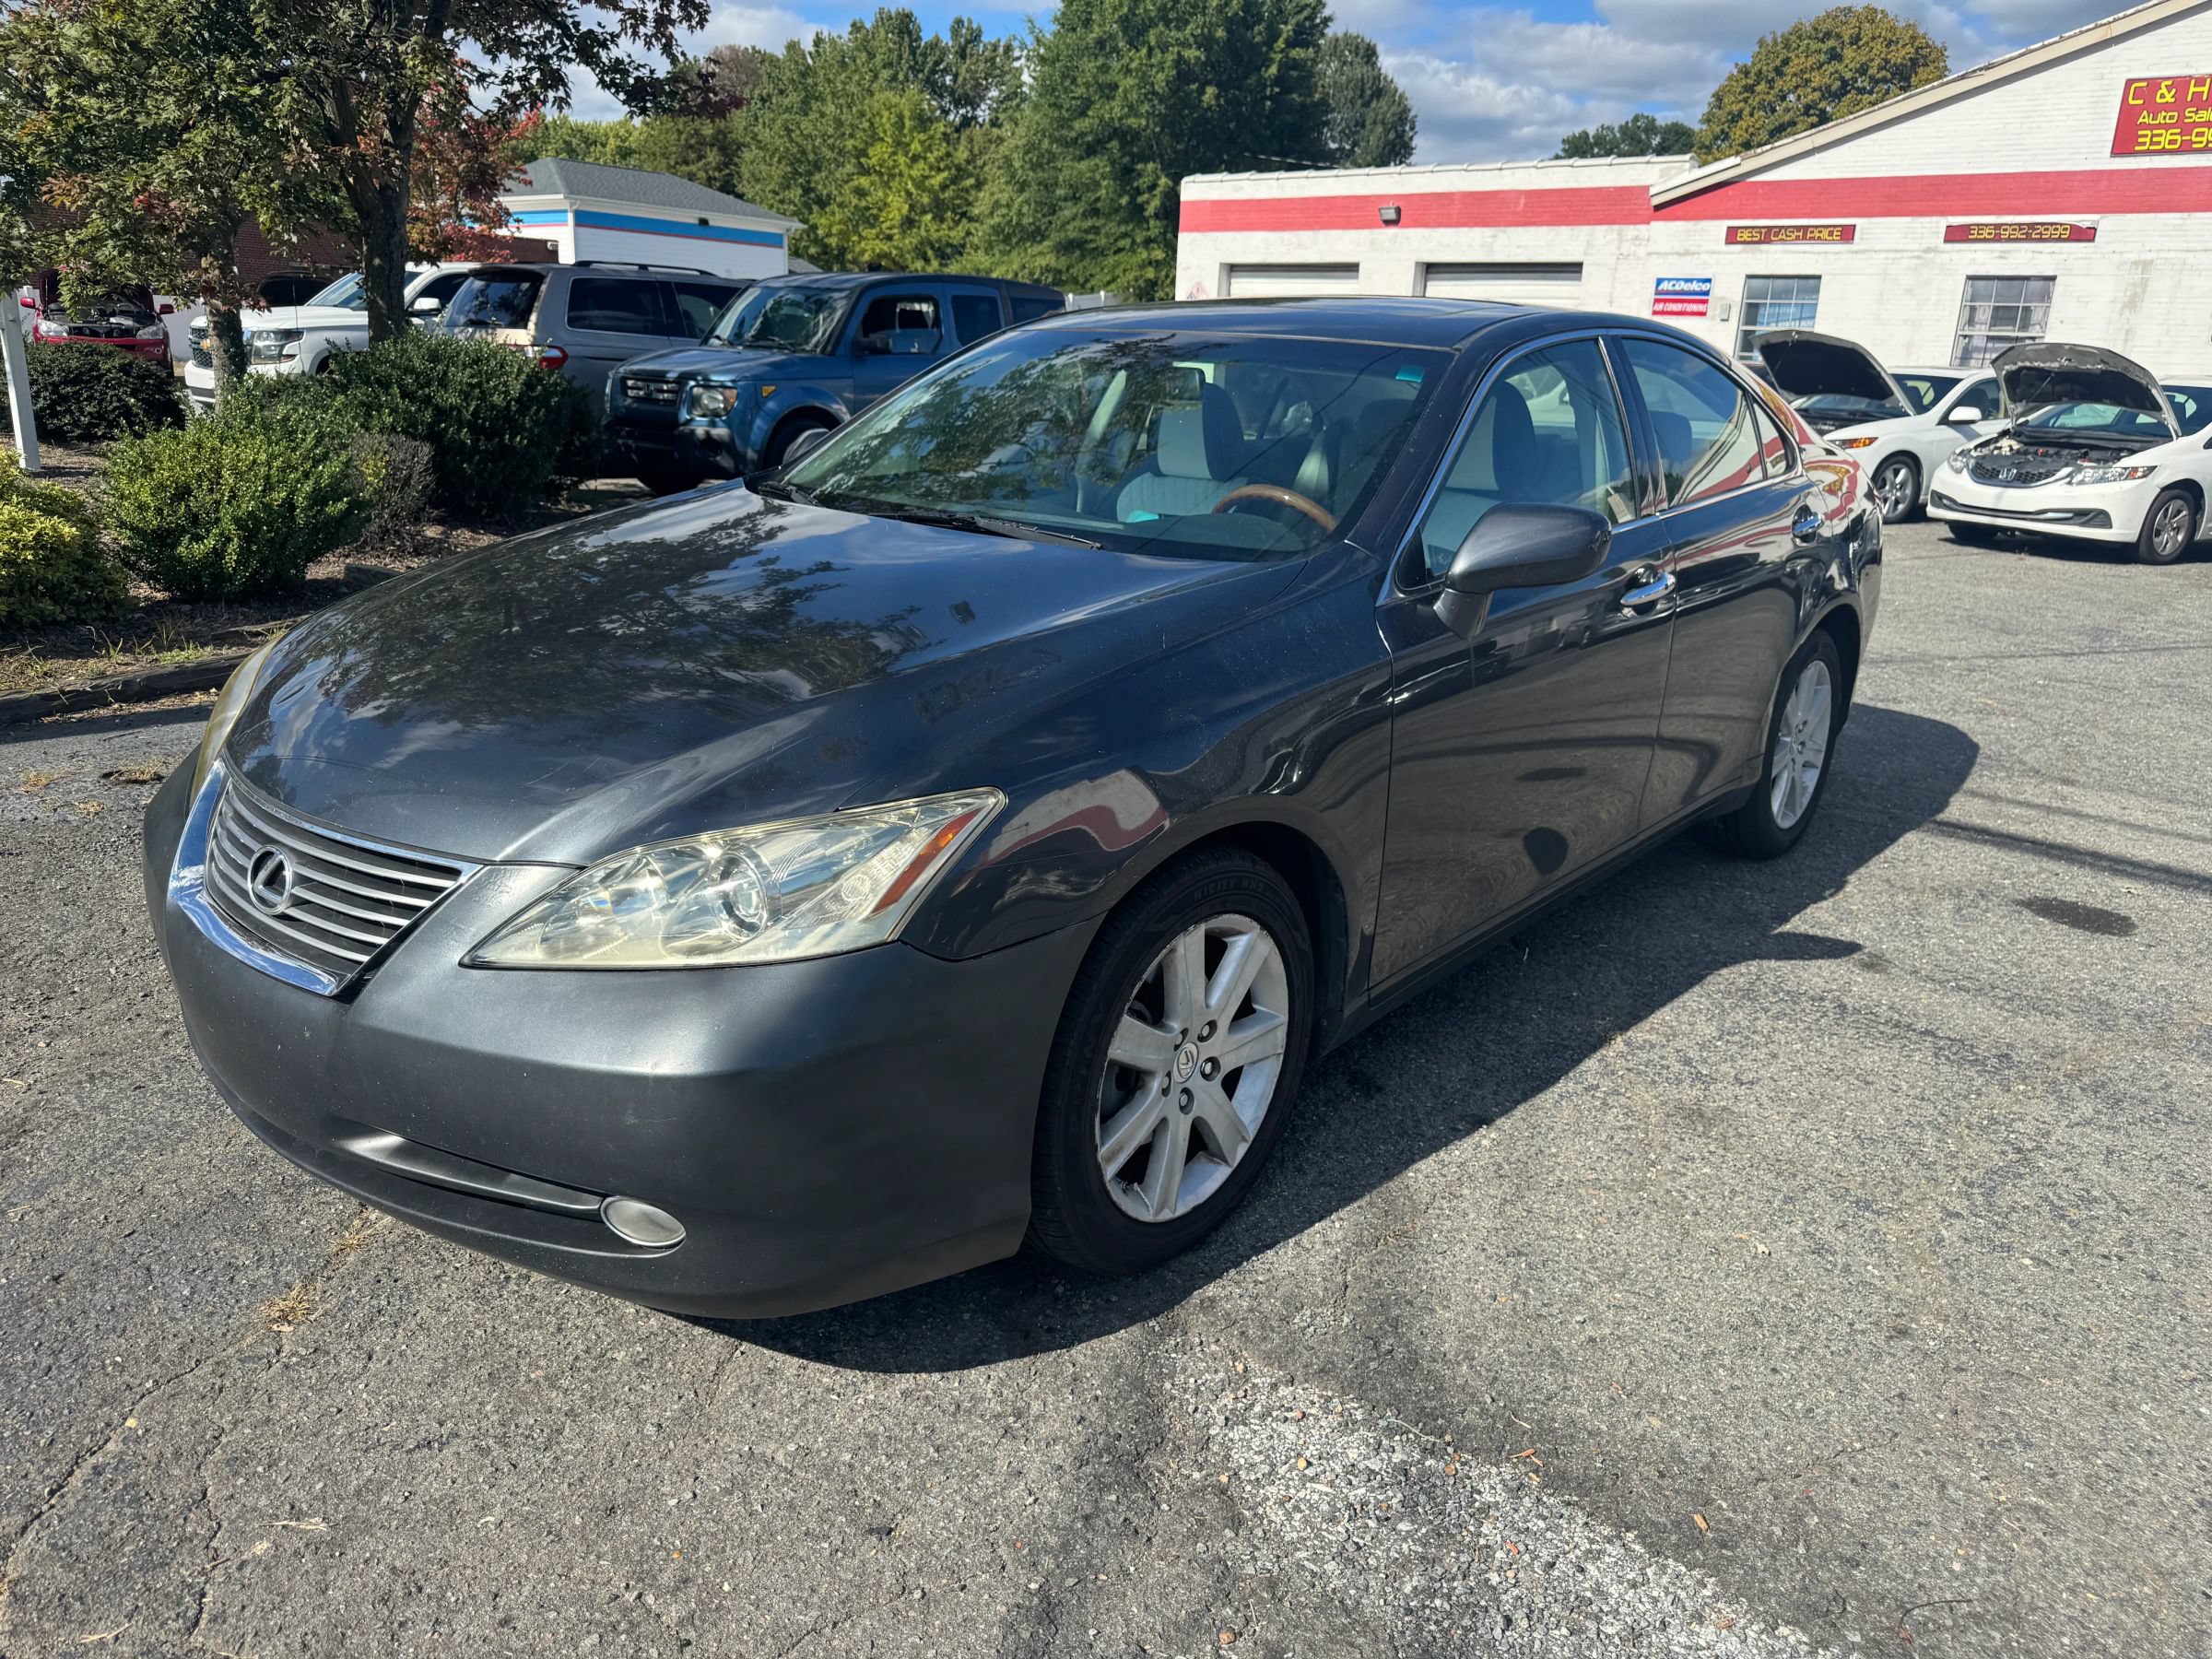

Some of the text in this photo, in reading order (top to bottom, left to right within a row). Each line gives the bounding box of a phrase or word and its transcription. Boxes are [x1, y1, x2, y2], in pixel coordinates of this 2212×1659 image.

[2128, 77, 2211, 105] C & H
[2136, 107, 2212, 124] Auto Sal
[1736, 227, 1842, 241] BEST CASH PRICE
[1968, 224, 2071, 240] 336-992-2999
[1657, 279, 1711, 291] ACDelco
[1653, 301, 1708, 312] AIR CONDITIONING
